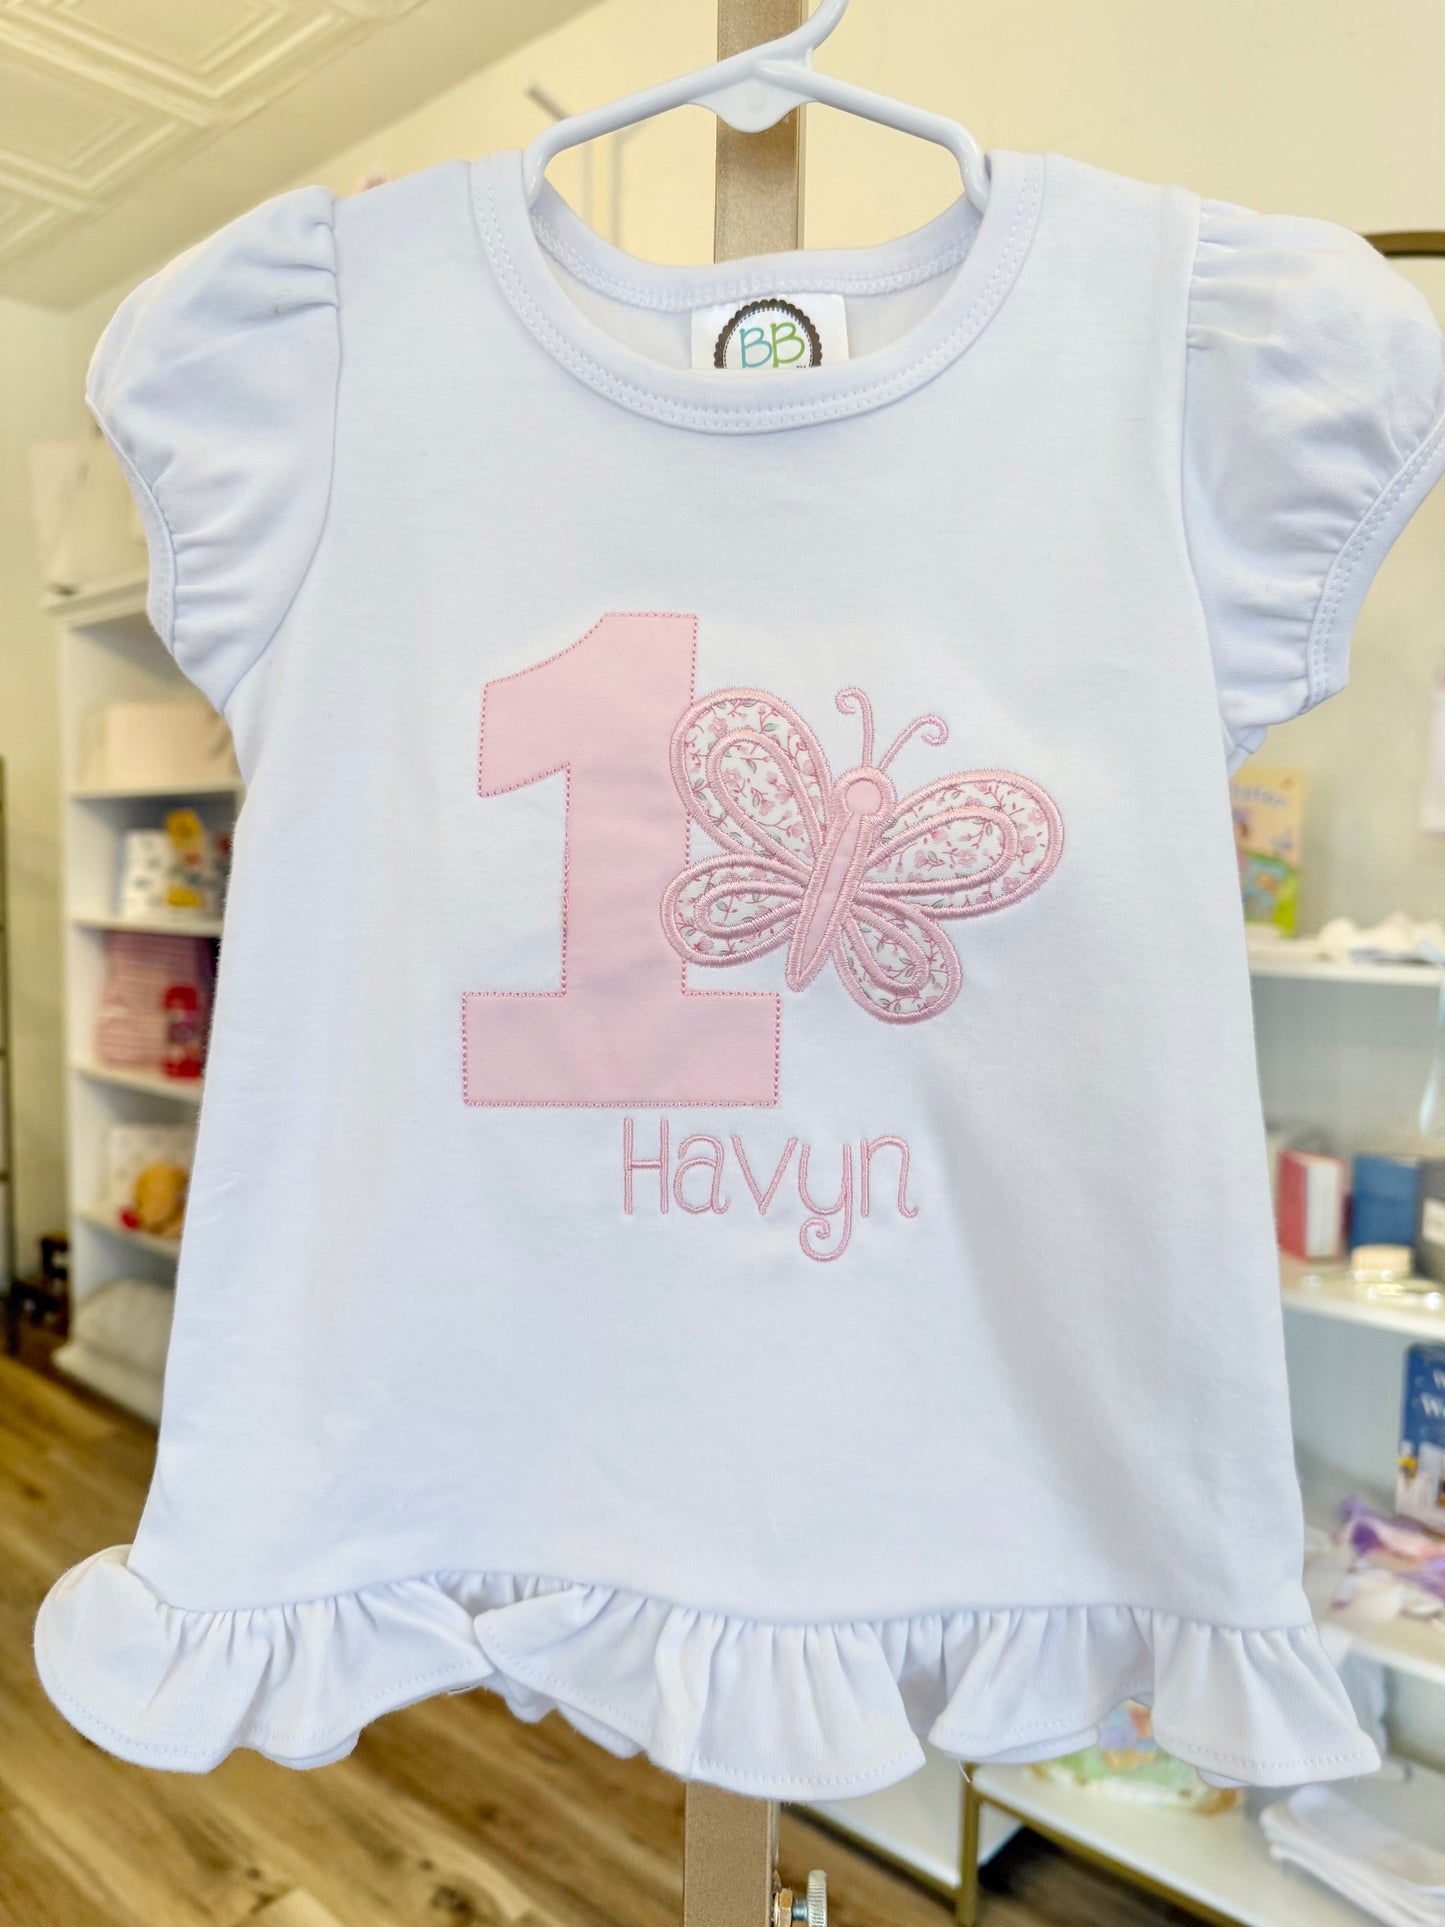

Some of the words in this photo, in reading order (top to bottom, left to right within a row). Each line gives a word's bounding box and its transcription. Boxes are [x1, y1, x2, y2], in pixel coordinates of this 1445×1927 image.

[739, 322, 805, 368] BB
[462, 611, 781, 1108] 1
[622, 1117, 919, 1262] Havyn
